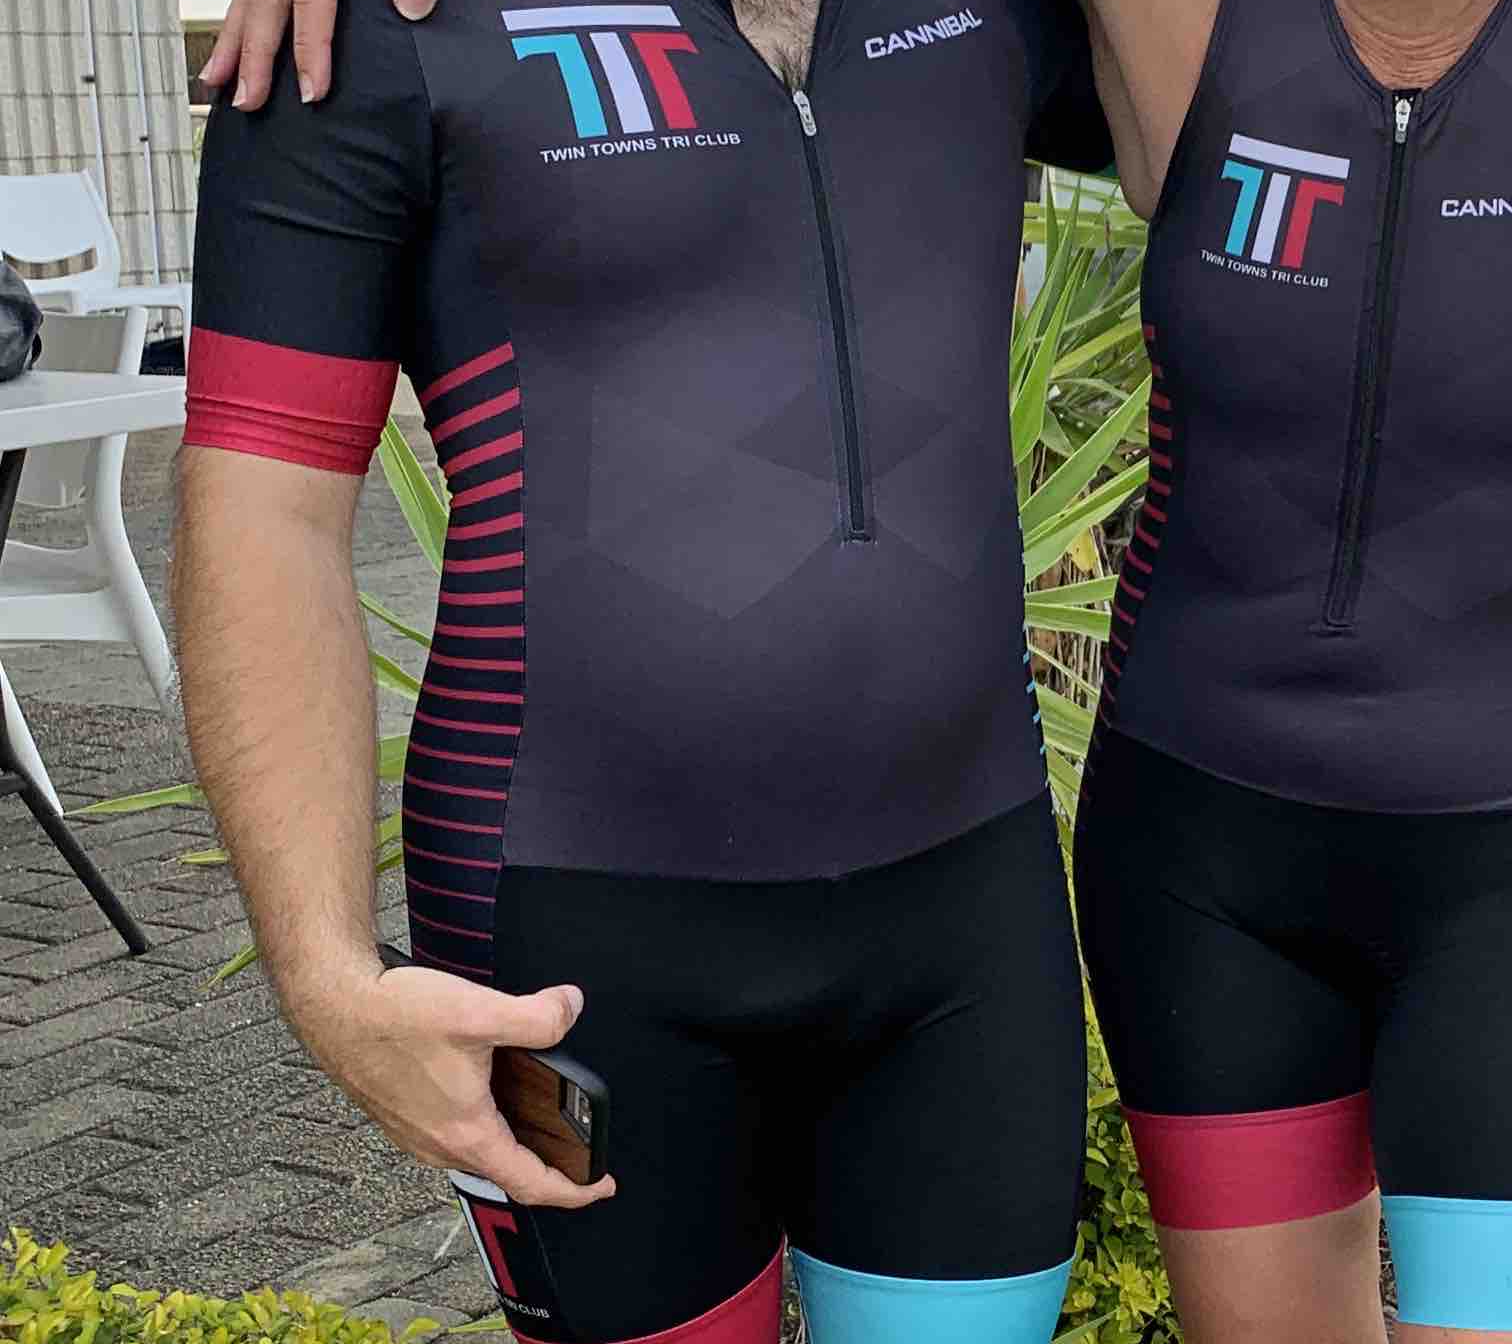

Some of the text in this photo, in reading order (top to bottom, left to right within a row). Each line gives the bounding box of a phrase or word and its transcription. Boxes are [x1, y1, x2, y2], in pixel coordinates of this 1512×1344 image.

[864, 7, 984, 60] CANNIBAL
[540, 132, 741, 163] TWIN TOWNS TRI CLUB
[1200, 249, 1329, 289] TWIN TOWNS TRI CLUB
